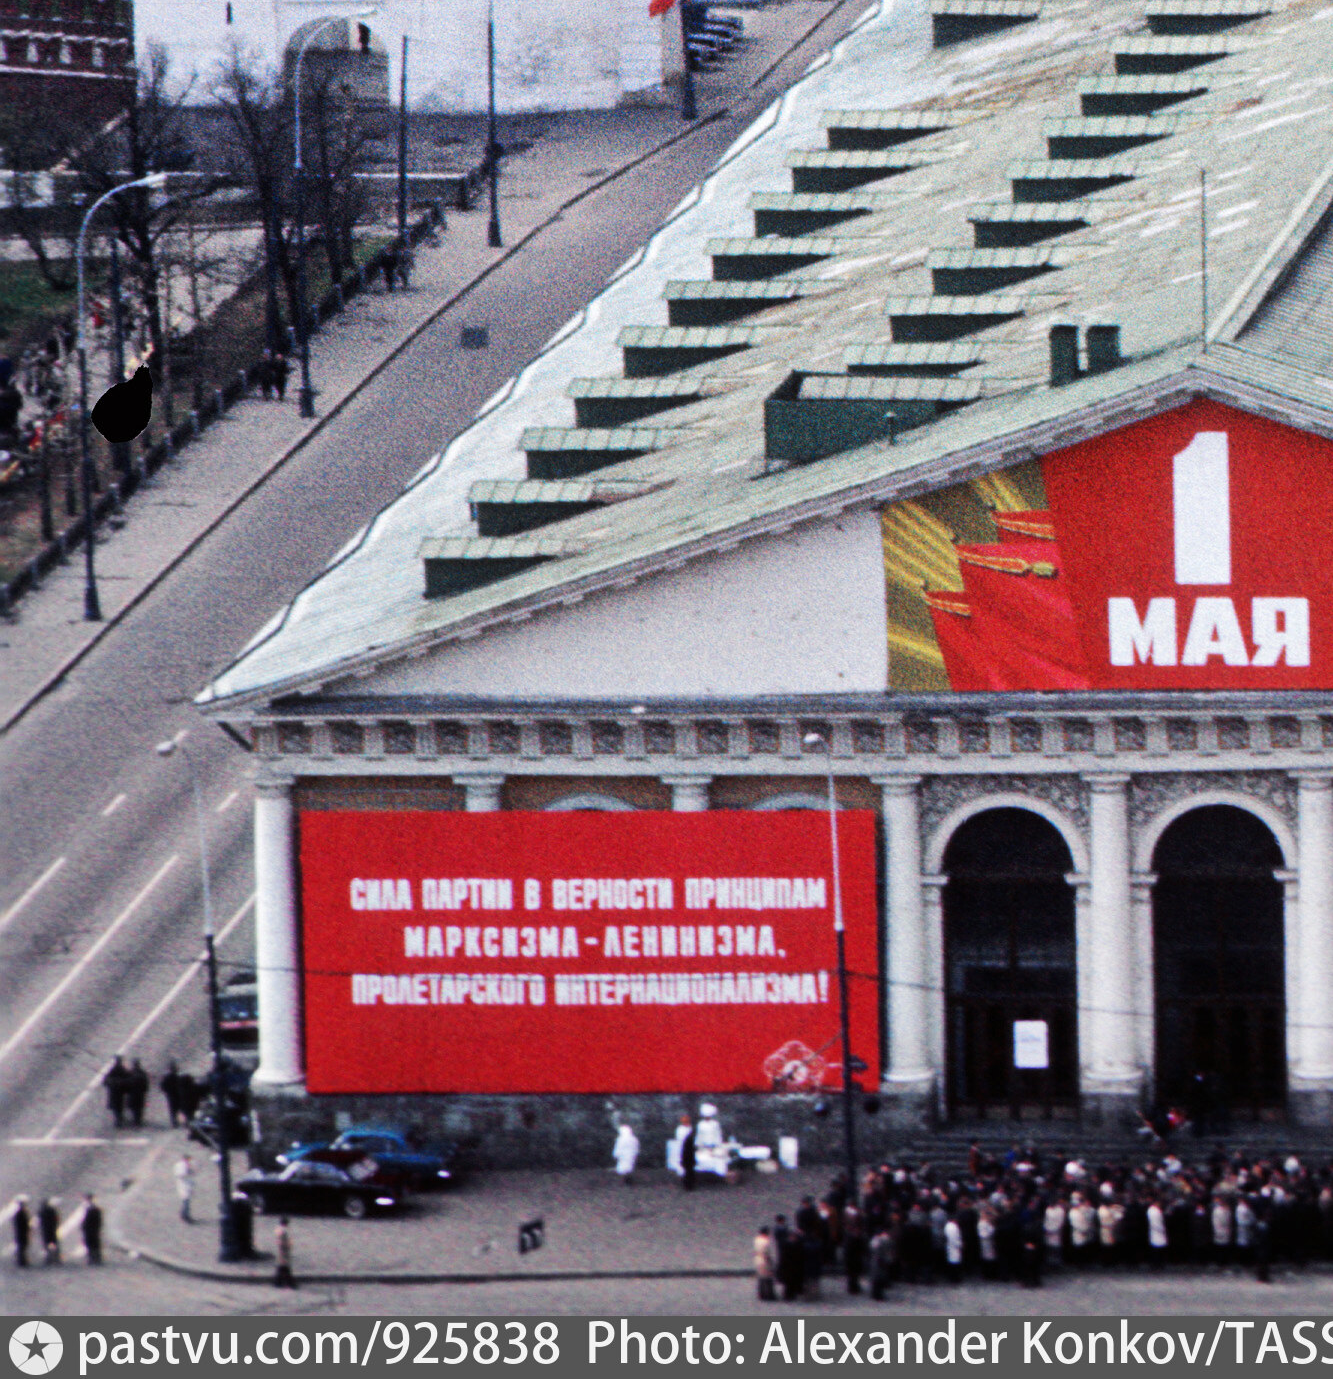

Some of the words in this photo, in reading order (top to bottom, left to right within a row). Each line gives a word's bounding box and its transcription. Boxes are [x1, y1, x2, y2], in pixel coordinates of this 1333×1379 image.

[1173, 431, 1231, 585] 1
[1108, 597, 1310, 666] МАЯ
[350, 878, 412, 911] СИЛА
[422, 878, 513, 910] ПАРТИИ
[523, 879, 541, 910] В
[552, 878, 674, 910] ВЕРНОСТИ
[684, 877, 827, 911] ПРИНЦИПАМ
[352, 973, 545, 1005] ПРОЛЕТАРСКОГО
[554, 971, 829, 1005] ИНТЕРНАЦИОНАЛИЗМА!
